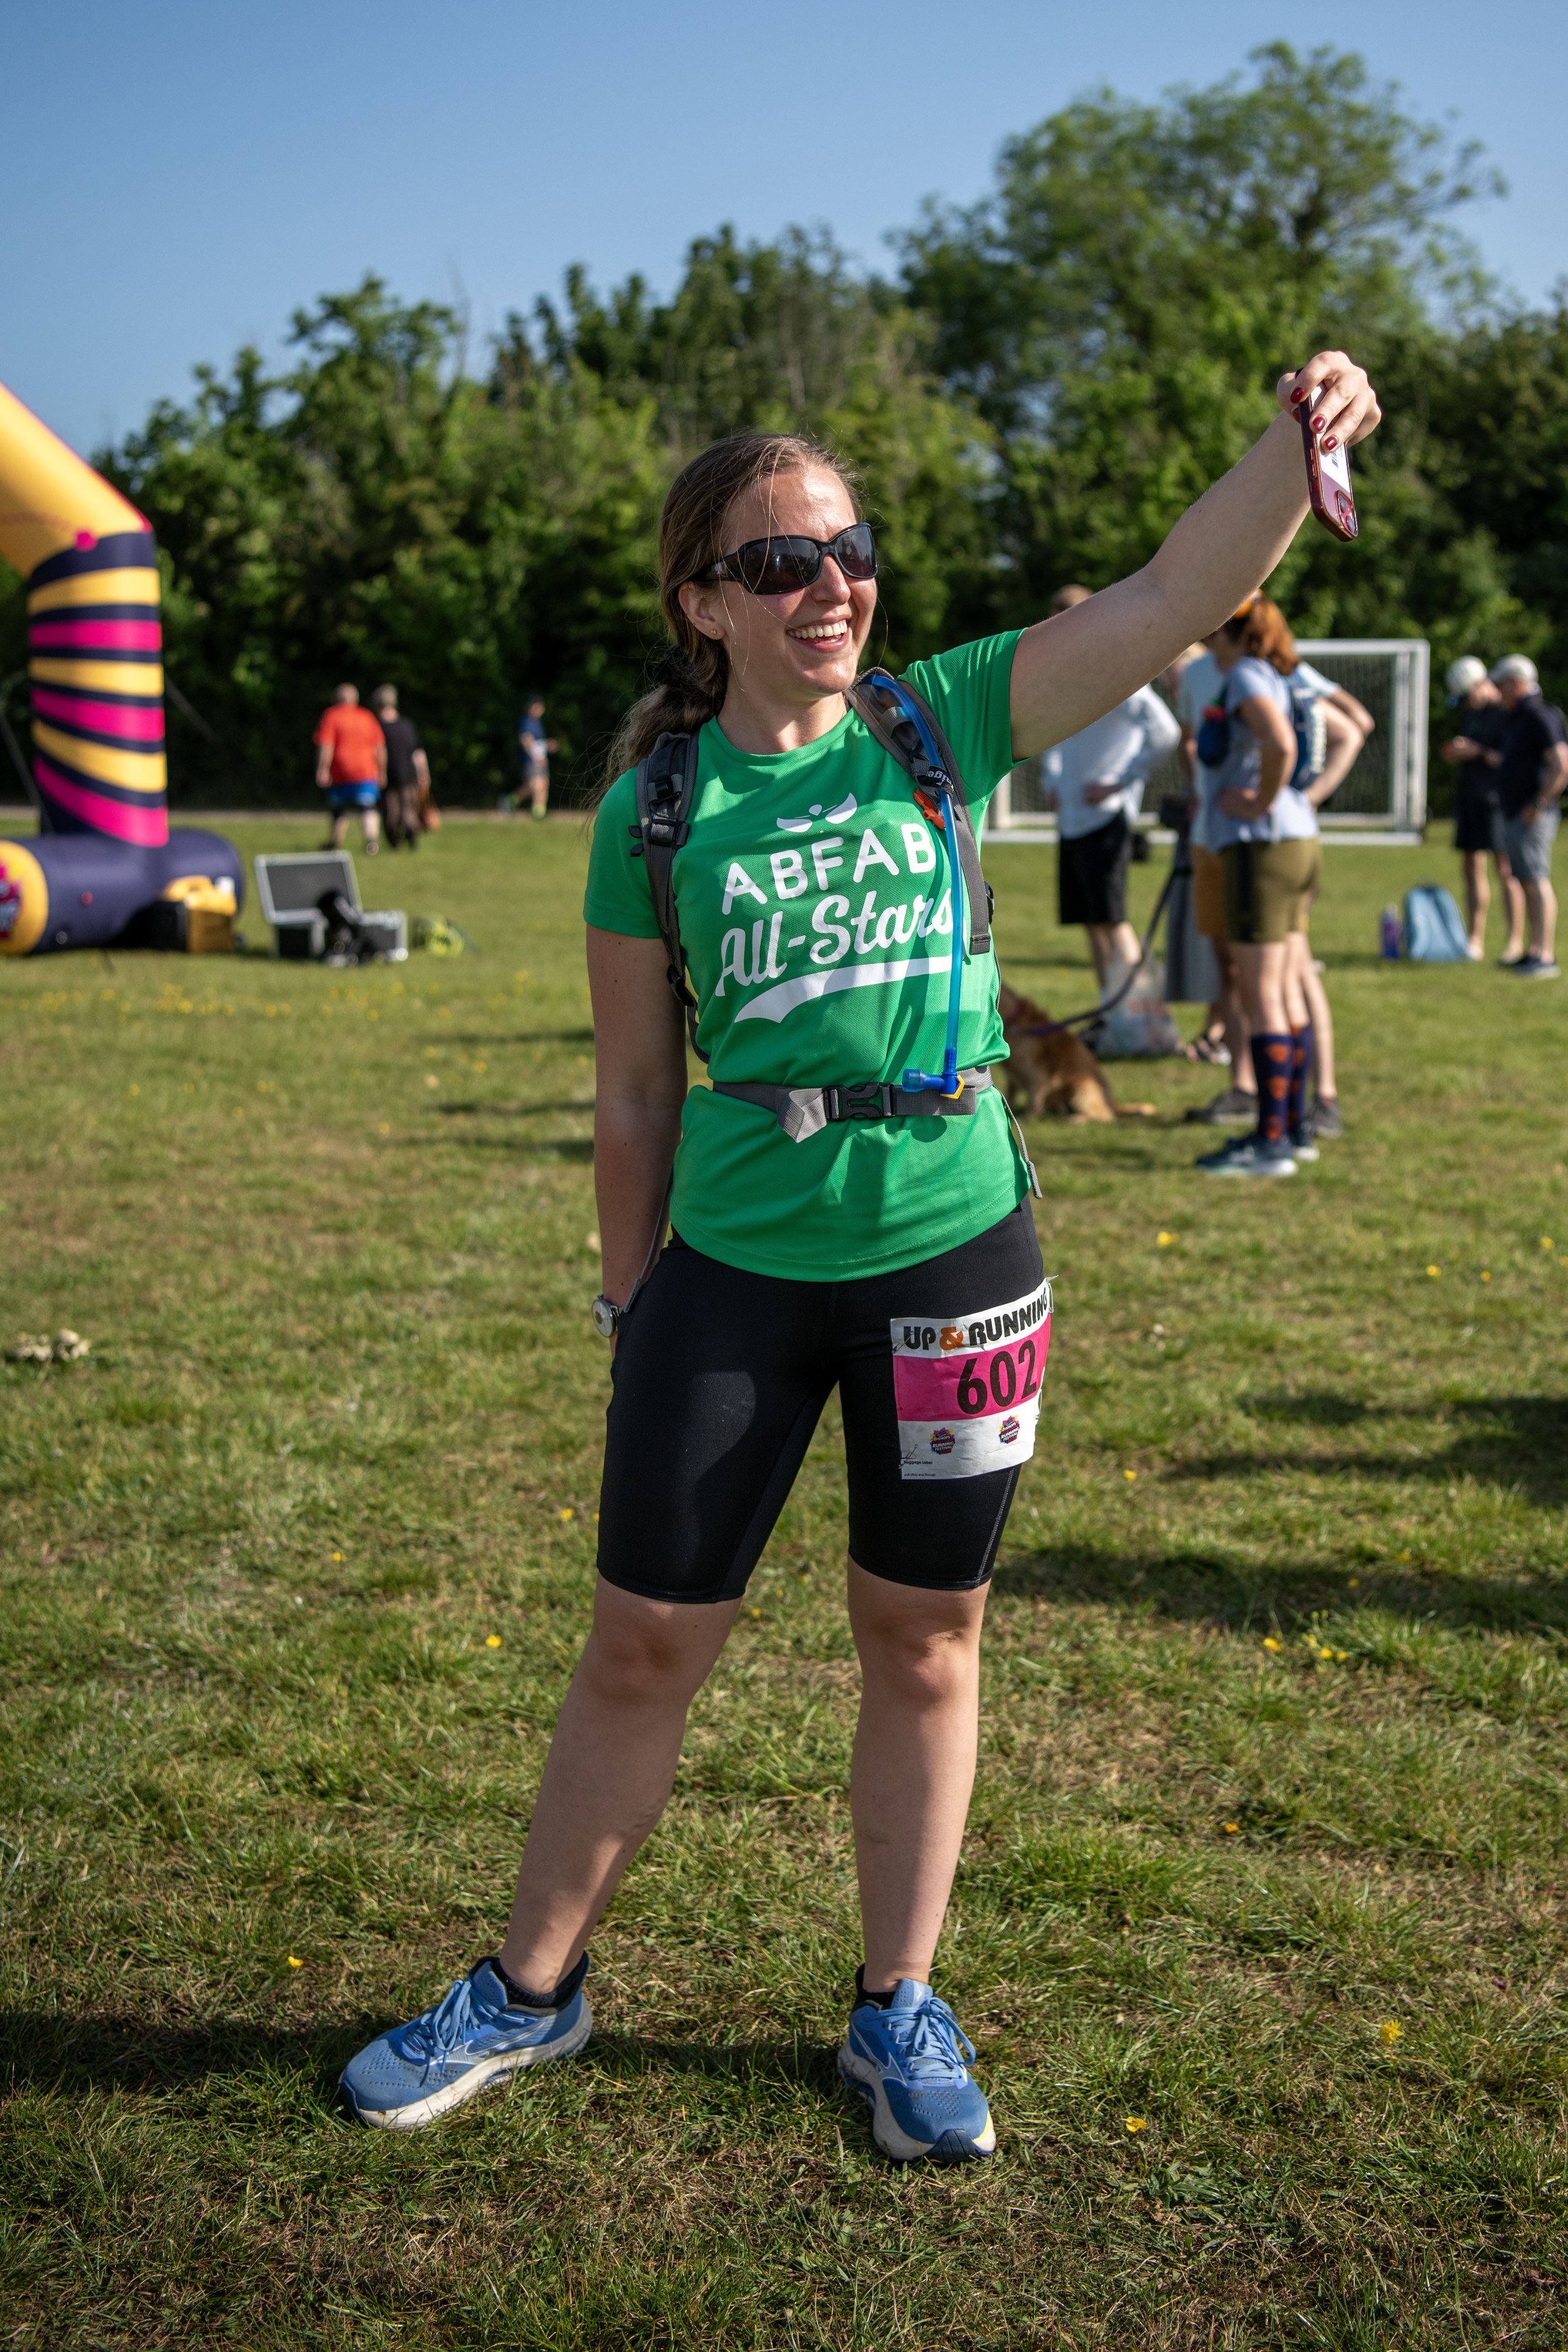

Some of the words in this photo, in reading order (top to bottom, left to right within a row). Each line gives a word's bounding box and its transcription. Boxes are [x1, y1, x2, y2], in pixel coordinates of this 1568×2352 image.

[722, 824, 936, 914] ABFAB
[715, 887, 956, 996] All-Stars
[904, 1325, 936, 1350] UP
[939, 1326, 964, 1350] &
[968, 1286, 1047, 1346] RUNNING
[956, 1340, 1037, 1414] 602
[1001, 1426, 1019, 1439] RUNNING
